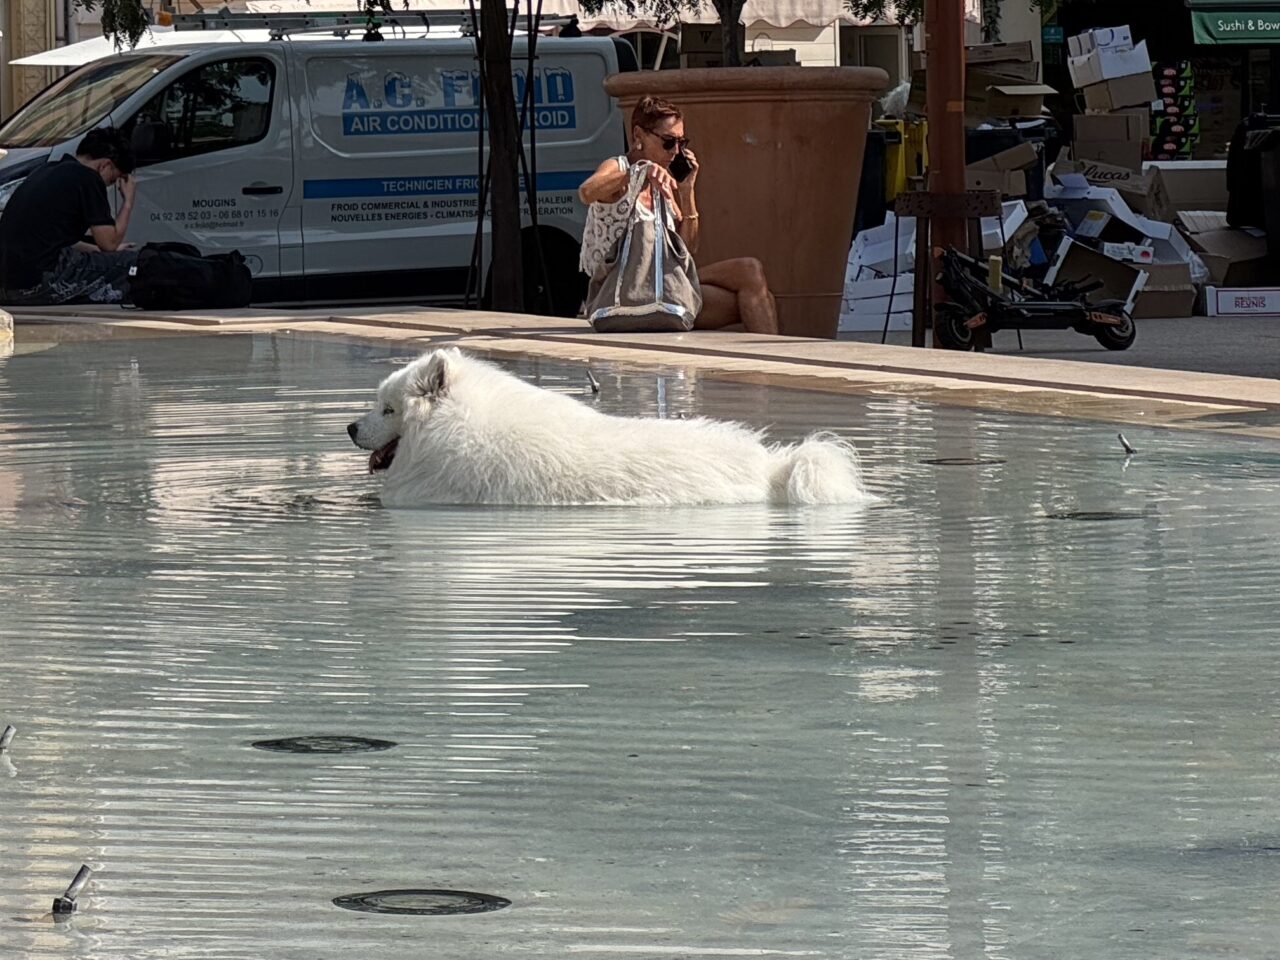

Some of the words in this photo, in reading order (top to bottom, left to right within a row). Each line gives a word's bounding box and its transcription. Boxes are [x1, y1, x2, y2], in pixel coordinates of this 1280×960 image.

[1217, 19, 1245, 31] Sushi
[1247, 19, 1255, 30] &
[350, 115, 382, 133] AIR
[382, 178, 453, 193] TECHNICIEN
[192, 198, 237, 208] MOUGINS
[331, 203, 359, 212] FROID
[360, 201, 420, 211] COMMERCIAL
[422, 200, 429, 209] &
[150, 213, 161, 222] 04
[162, 212, 173, 221] 92
[175, 211, 186, 220] 28
[187, 211, 198, 220] 52
[200, 211, 211, 220] 03
[219, 211, 230, 220] 06
[231, 210, 242, 219] 68
[243, 210, 254, 219] 01
[257, 210, 267, 218] 15
[269, 209, 279, 218] 16
[331, 212, 382, 223] NOUVELLES
[385, 211, 428, 222] ENERGIES
